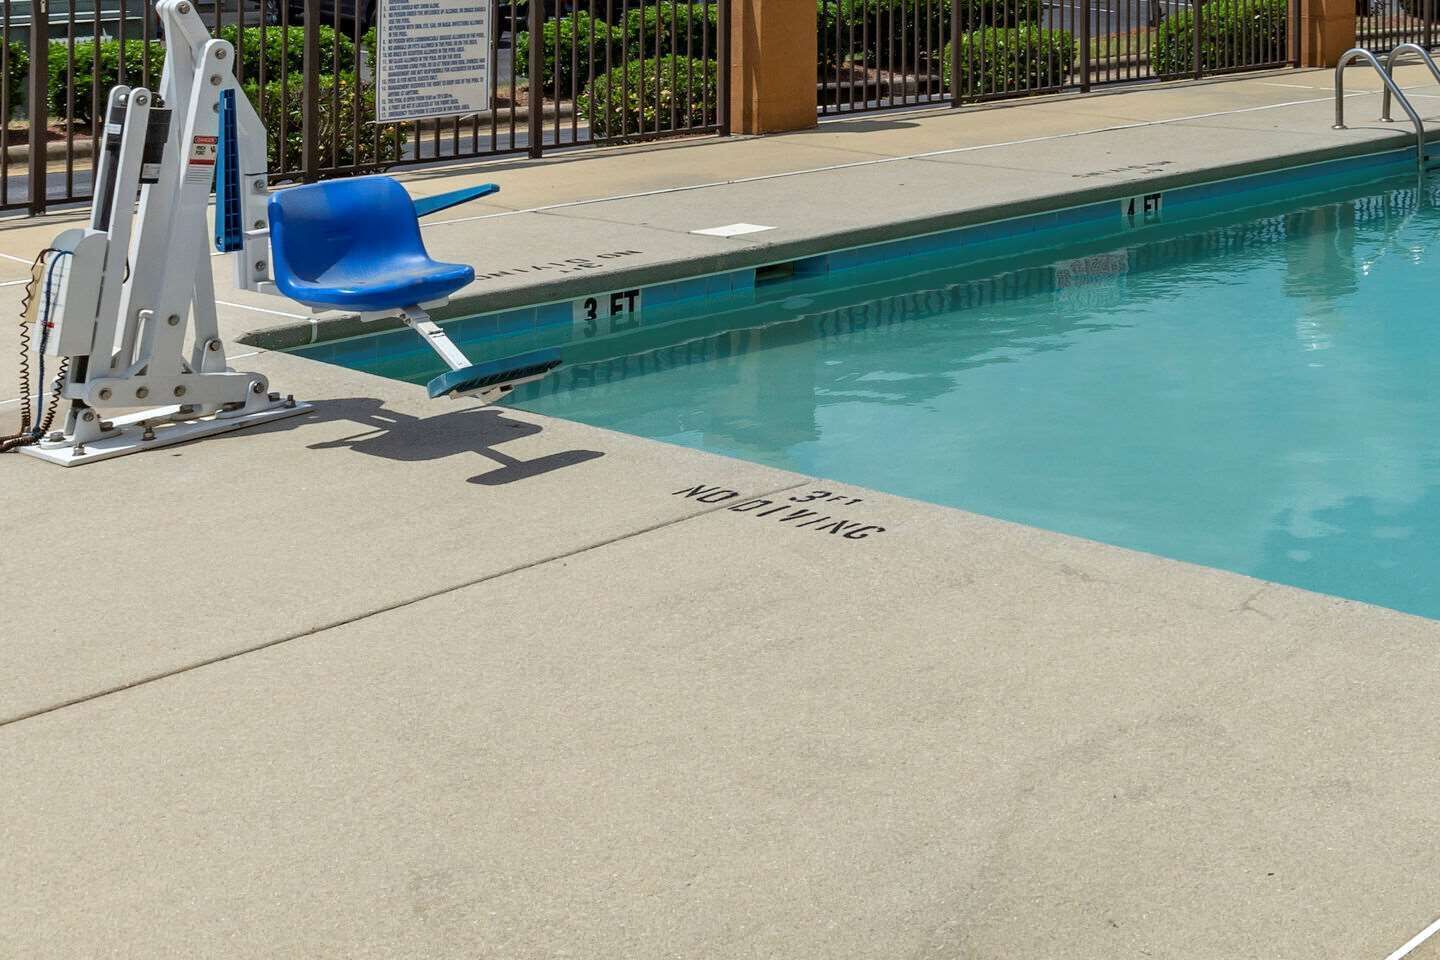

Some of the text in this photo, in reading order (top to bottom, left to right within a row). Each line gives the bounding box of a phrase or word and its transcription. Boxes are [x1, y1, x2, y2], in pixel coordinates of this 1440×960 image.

[1127, 193, 1161, 216] 4 FT
[584, 289, 640, 321] 3 FT
[671, 484, 885, 539] NO DIVING
